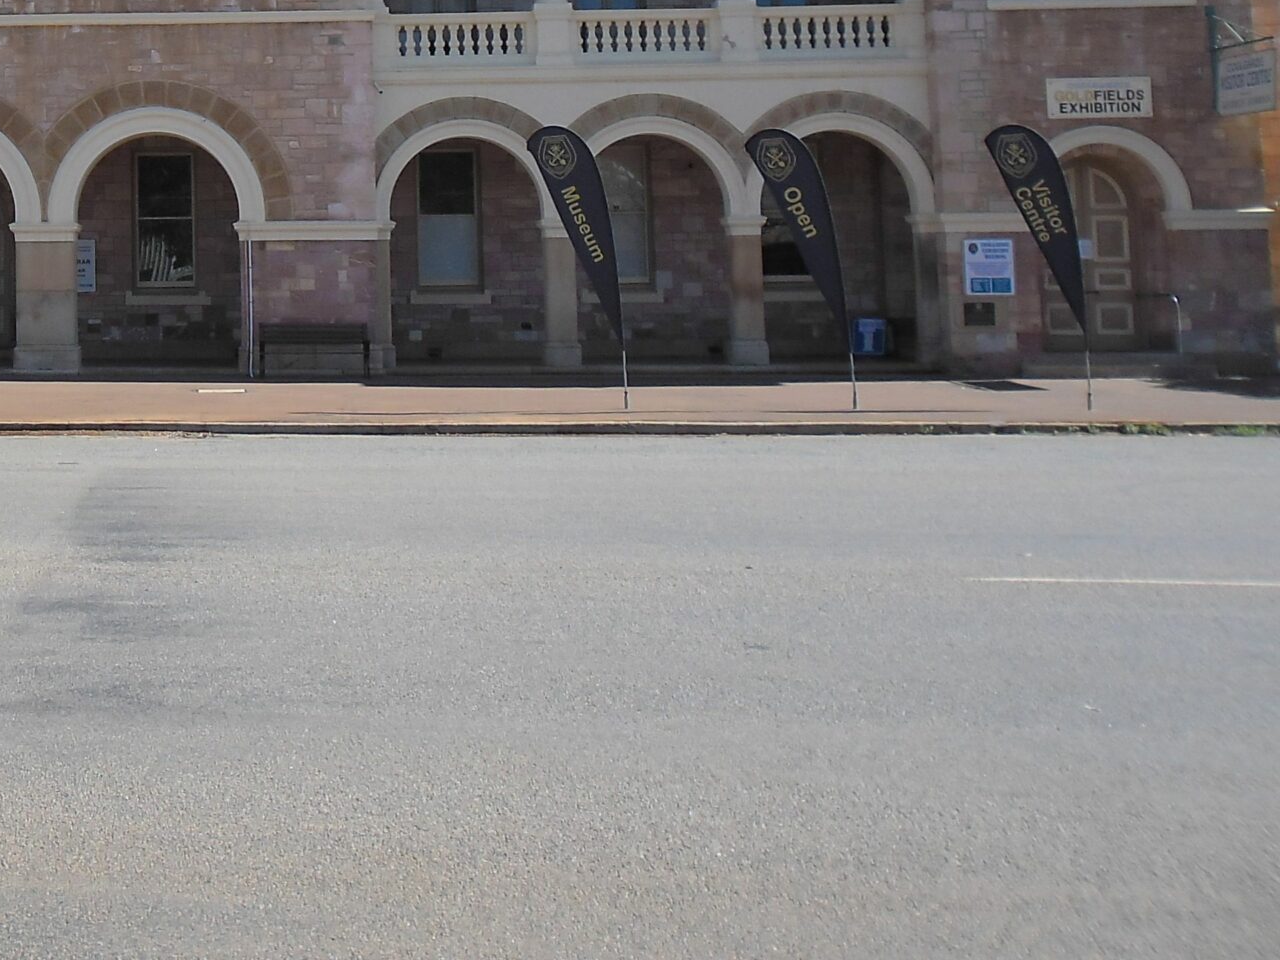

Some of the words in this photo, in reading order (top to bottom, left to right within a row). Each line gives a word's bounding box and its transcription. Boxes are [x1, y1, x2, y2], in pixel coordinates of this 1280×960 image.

[1055, 89, 1145, 102] GOLDFIELDS
[1059, 102, 1142, 114] EXHIBITION
[561, 185, 604, 263] Museum
[784, 187, 817, 239] Open
[1016, 187, 1050, 242] Centre
[1032, 179, 1067, 234] Visitor
